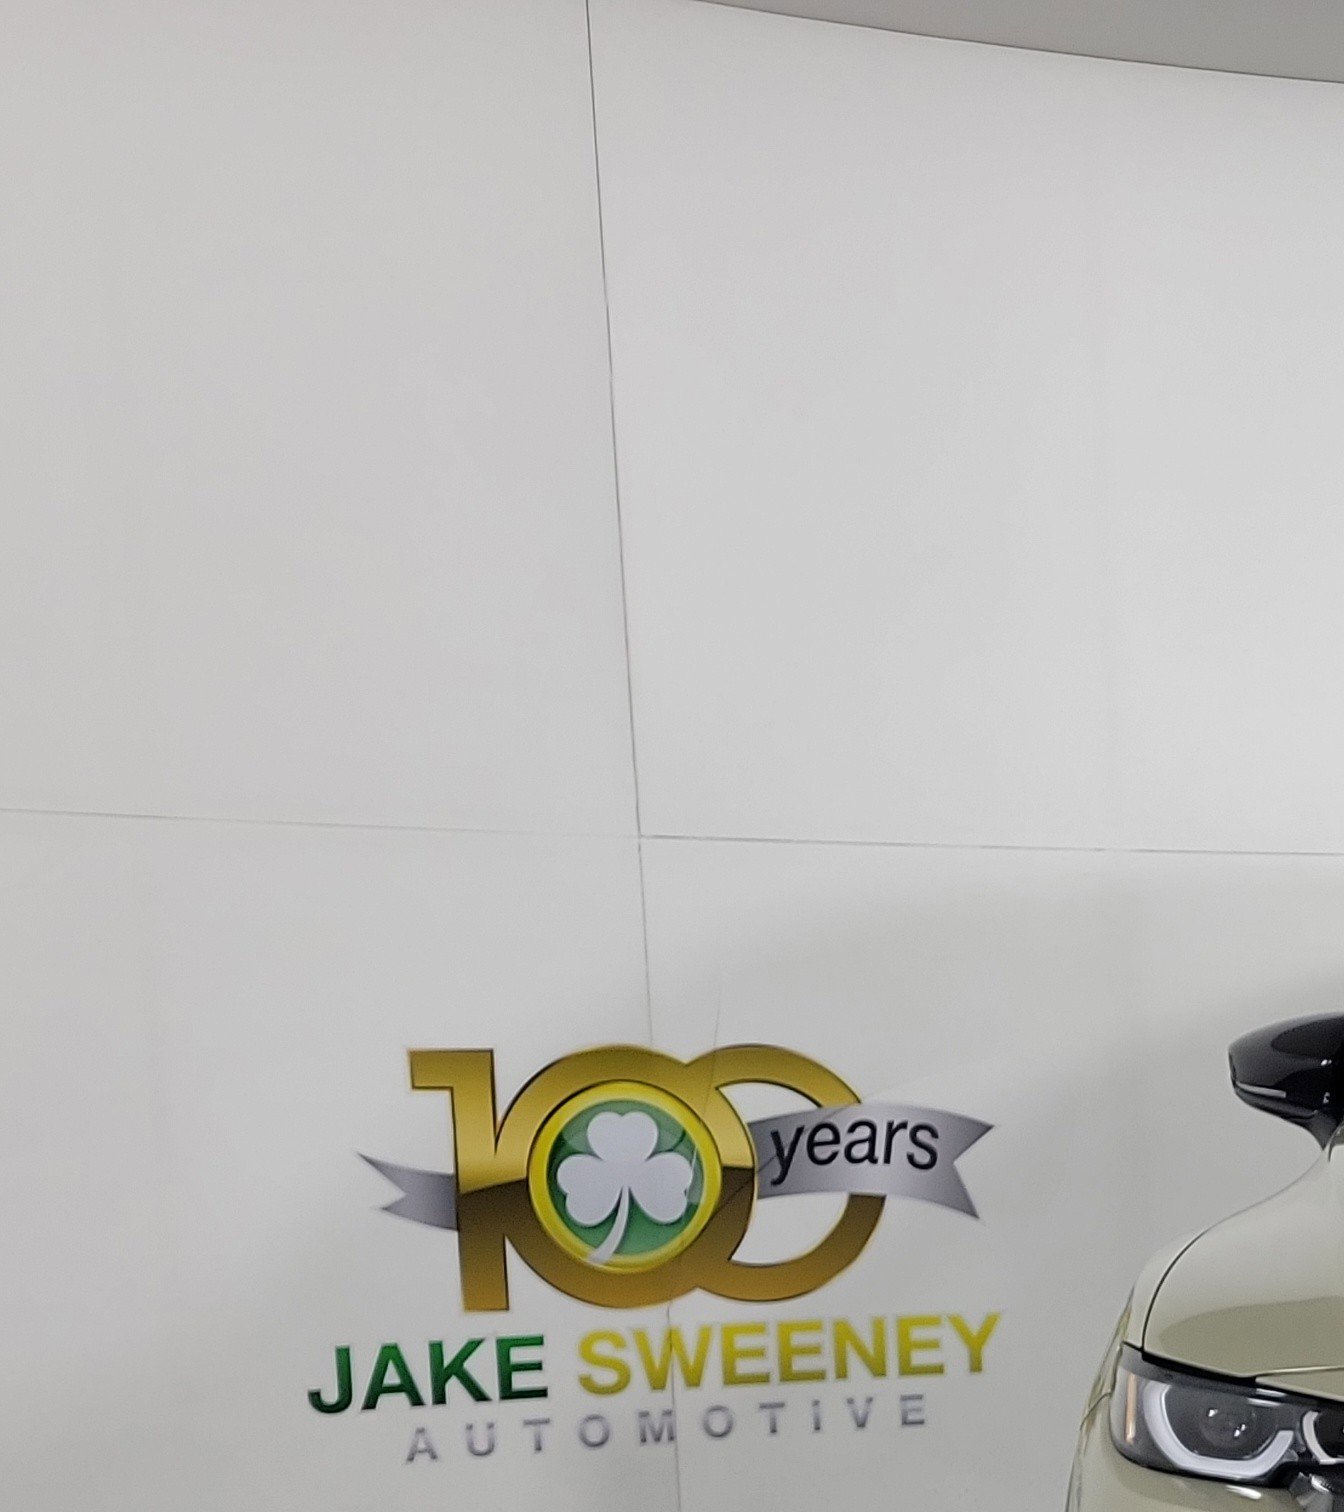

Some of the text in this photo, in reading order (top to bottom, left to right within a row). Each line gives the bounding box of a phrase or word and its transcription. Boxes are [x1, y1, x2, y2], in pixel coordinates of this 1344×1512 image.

[408, 1044, 939, 1311] 100 years
[308, 1313, 1001, 1414] JAKE SWEENEY
[405, 1394, 926, 1463] AUTOMOTIVE
